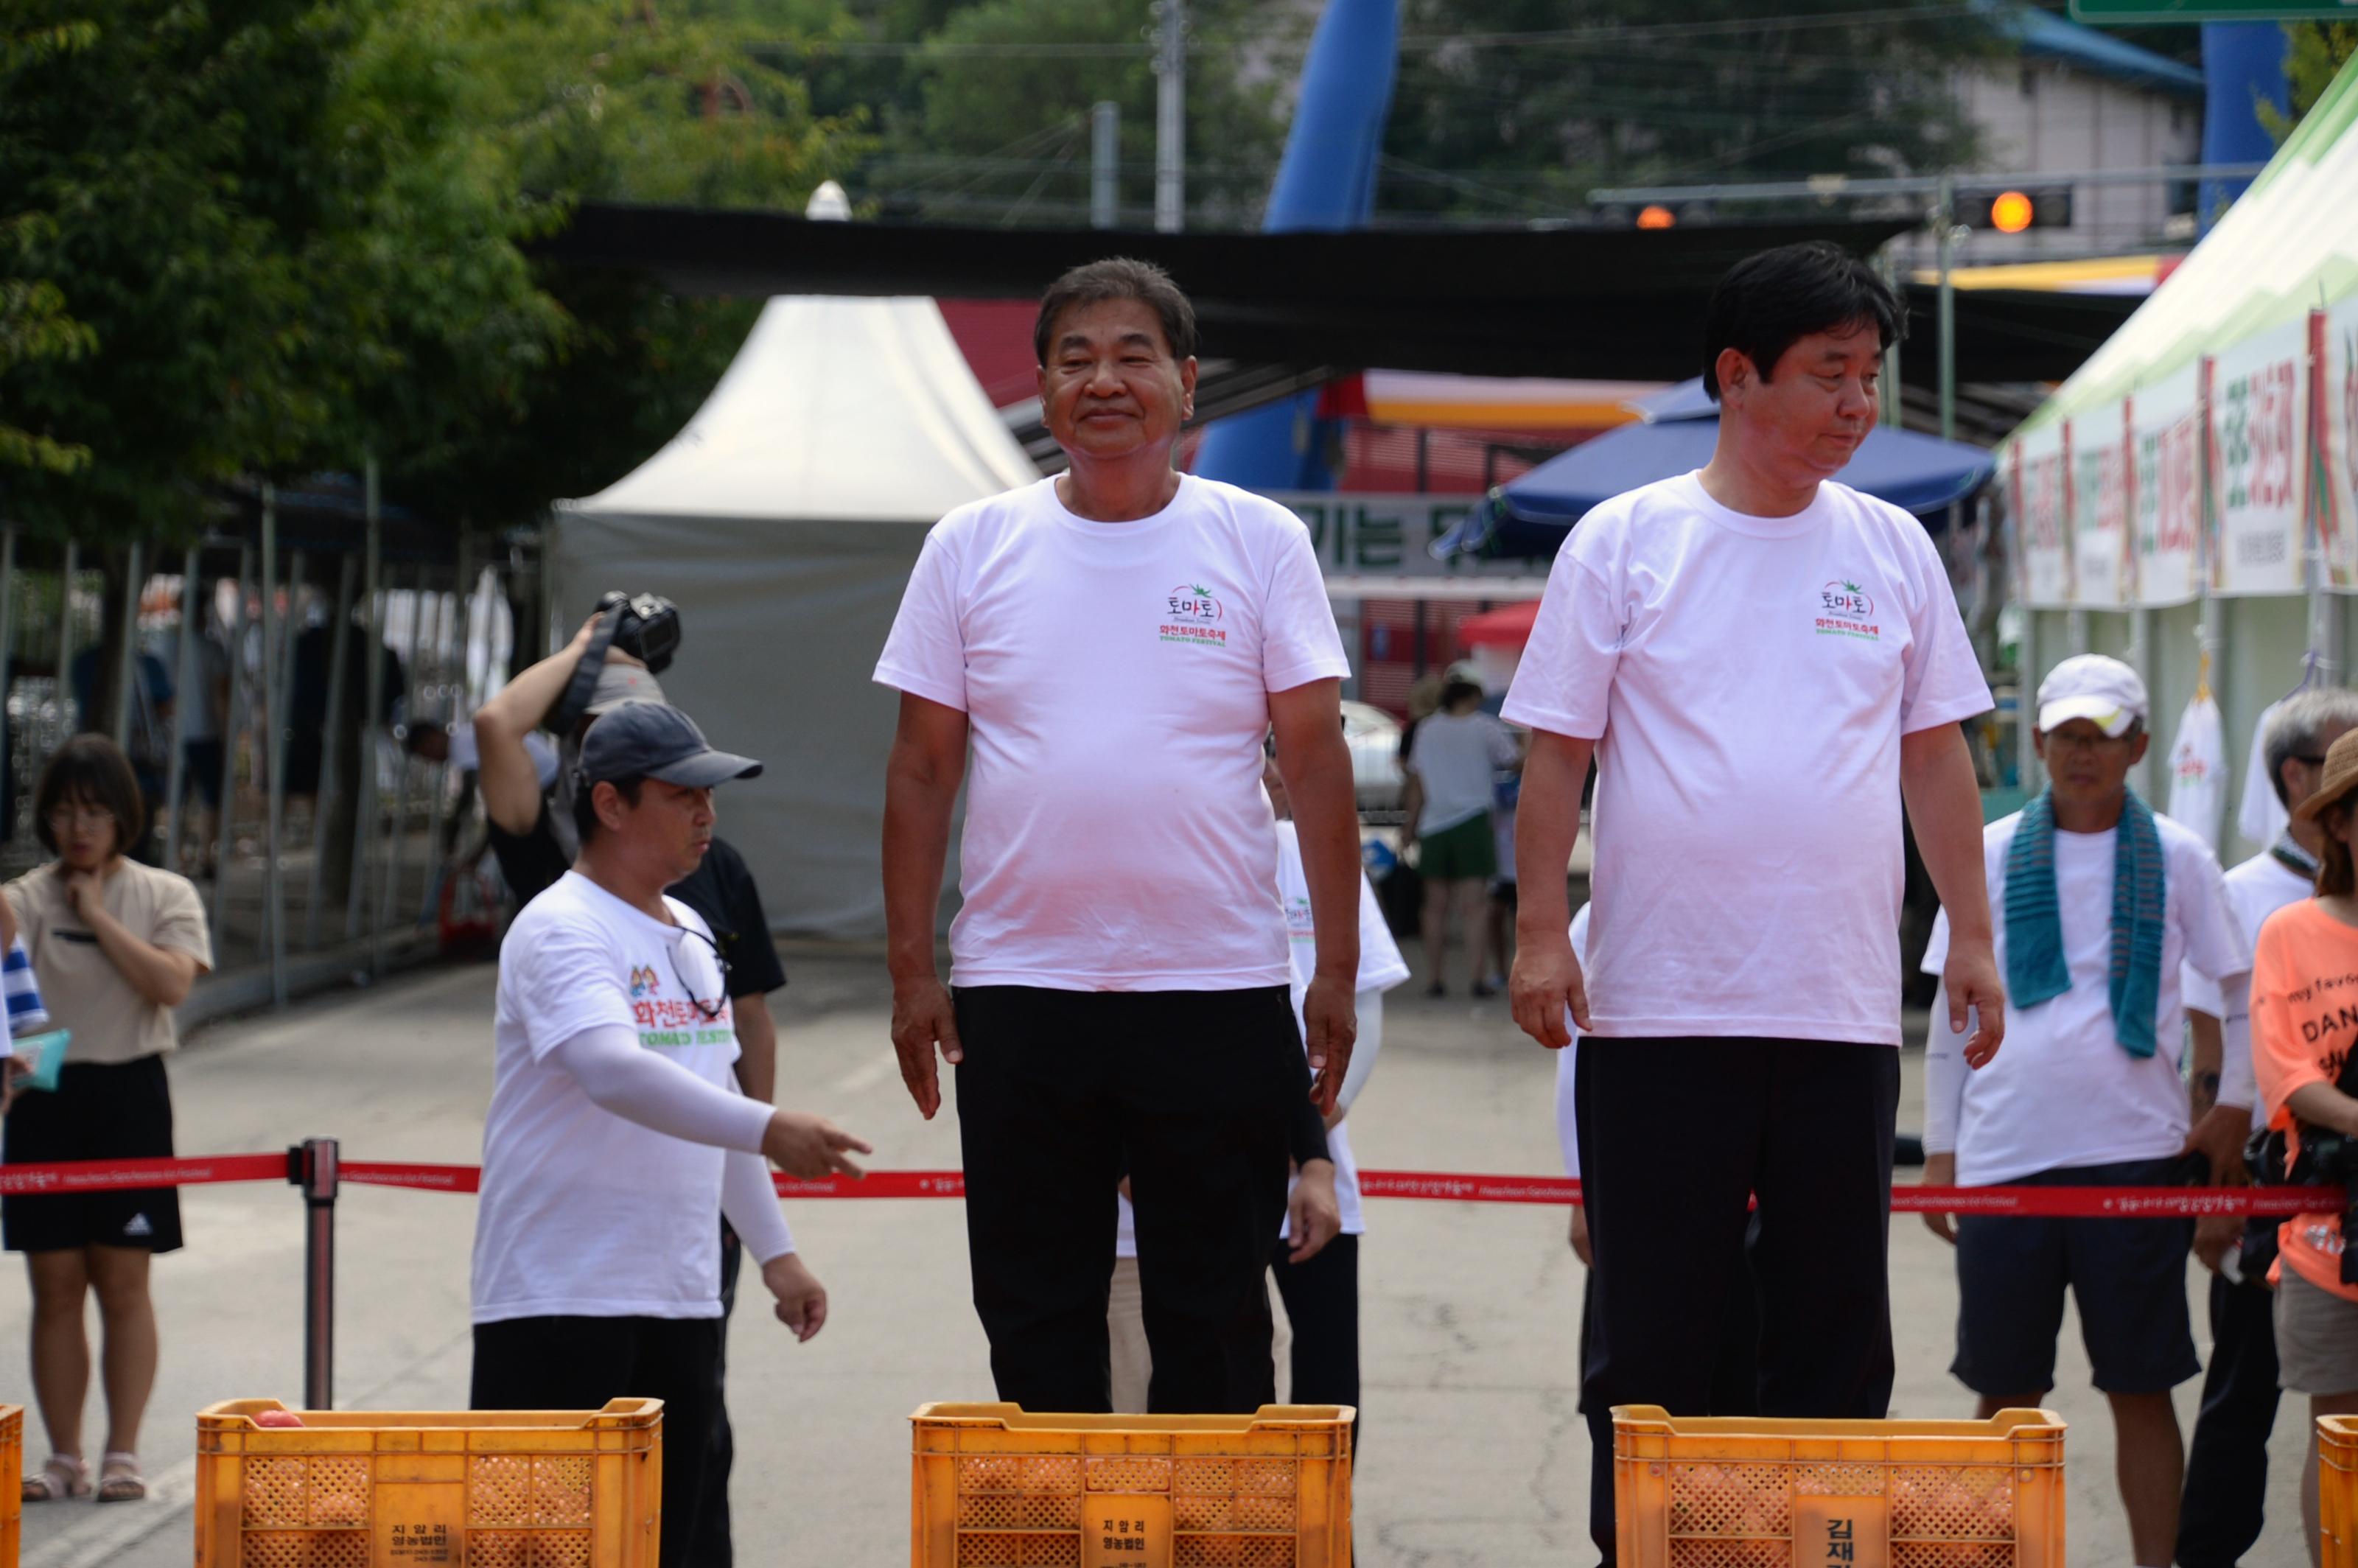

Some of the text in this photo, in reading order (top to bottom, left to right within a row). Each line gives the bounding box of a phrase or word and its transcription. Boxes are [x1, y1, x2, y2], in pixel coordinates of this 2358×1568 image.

[1167, 597, 1214, 617] 토마토
[1822, 592, 1867, 613] 토마토
[1103, 1537, 1145, 1550] 영농법인
